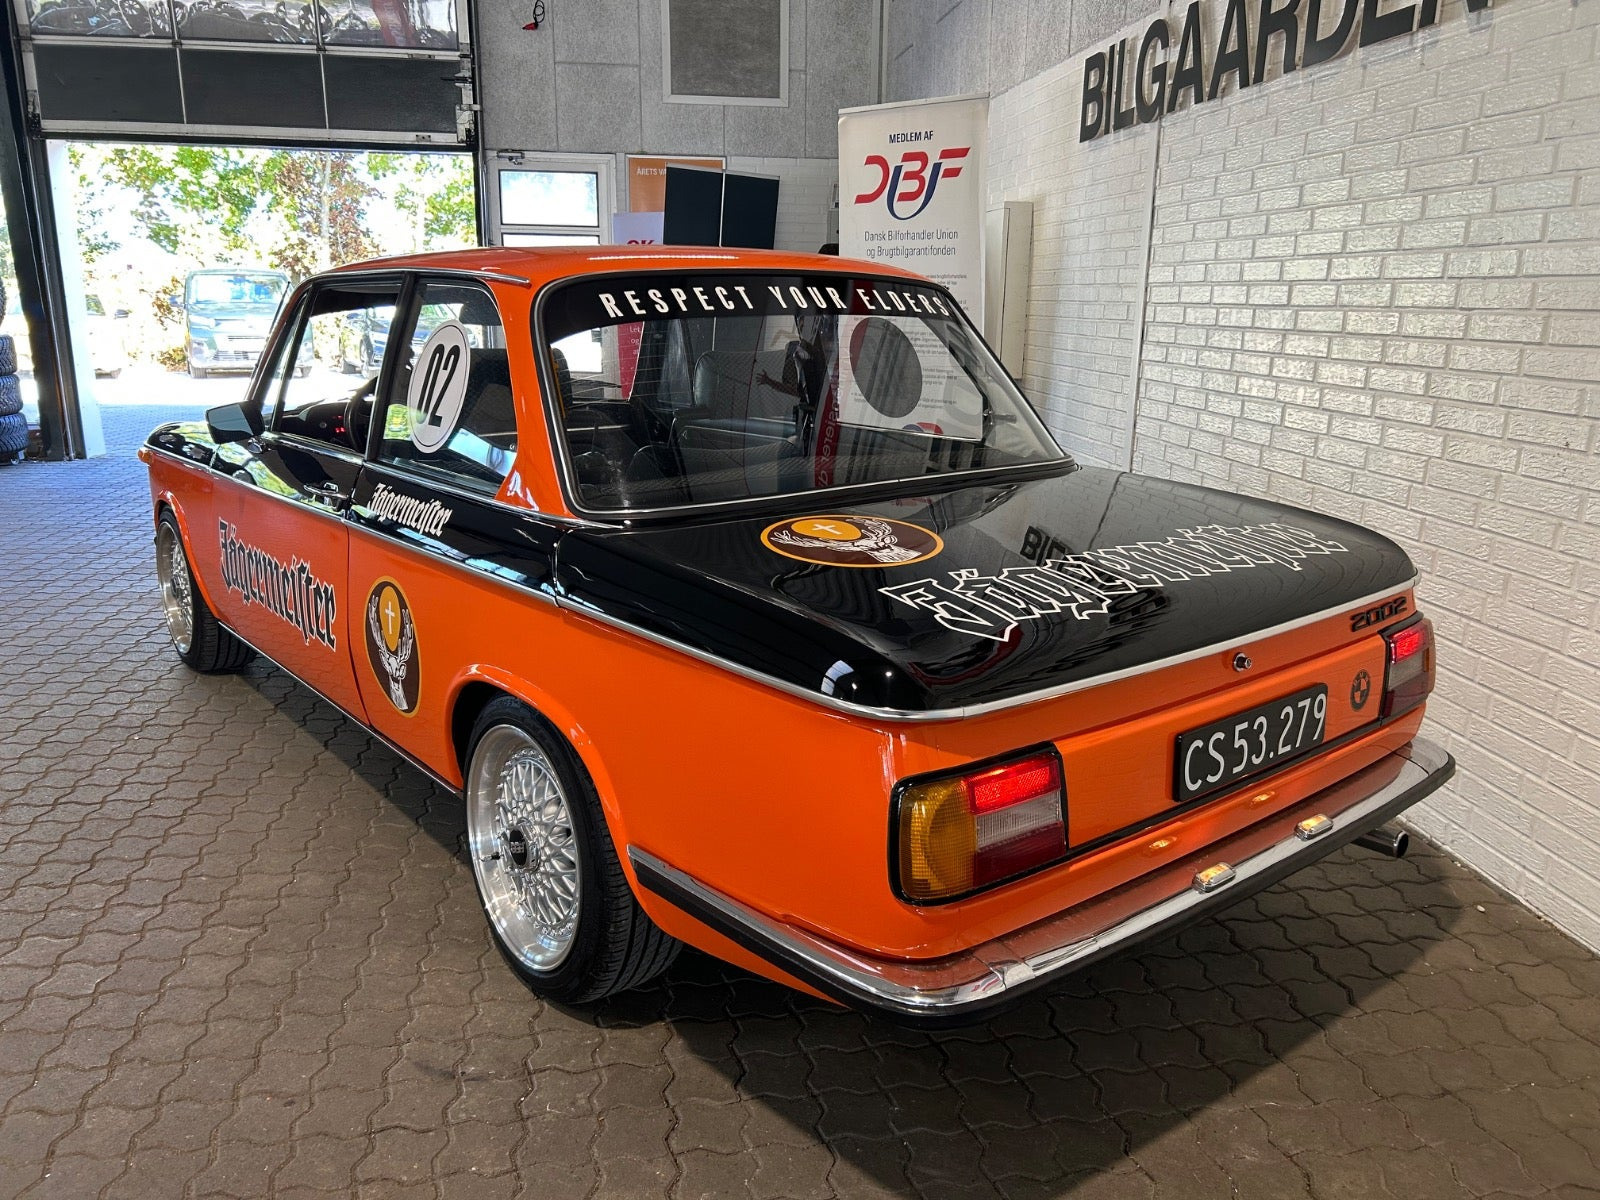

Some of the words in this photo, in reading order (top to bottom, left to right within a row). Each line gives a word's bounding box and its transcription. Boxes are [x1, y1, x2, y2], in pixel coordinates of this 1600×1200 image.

[889, 133, 922, 144] MEDLEM
[923, 130, 934, 141] AF
[636, 166, 658, 176] ÅRETS
[864, 231, 886, 242] Dansk
[887, 229, 935, 241] Bilforhandler
[936, 228, 959, 240] Union
[866, 248, 876, 259] og
[877, 246, 956, 258] Brugtbilgarantifonden
[599, 286, 754, 319] RESPECT
[767, 285, 848, 310] YOUR
[856, 288, 950, 317] ELDERS
[416, 343, 461, 428] 02
[1350, 596, 1408, 632] 2002
